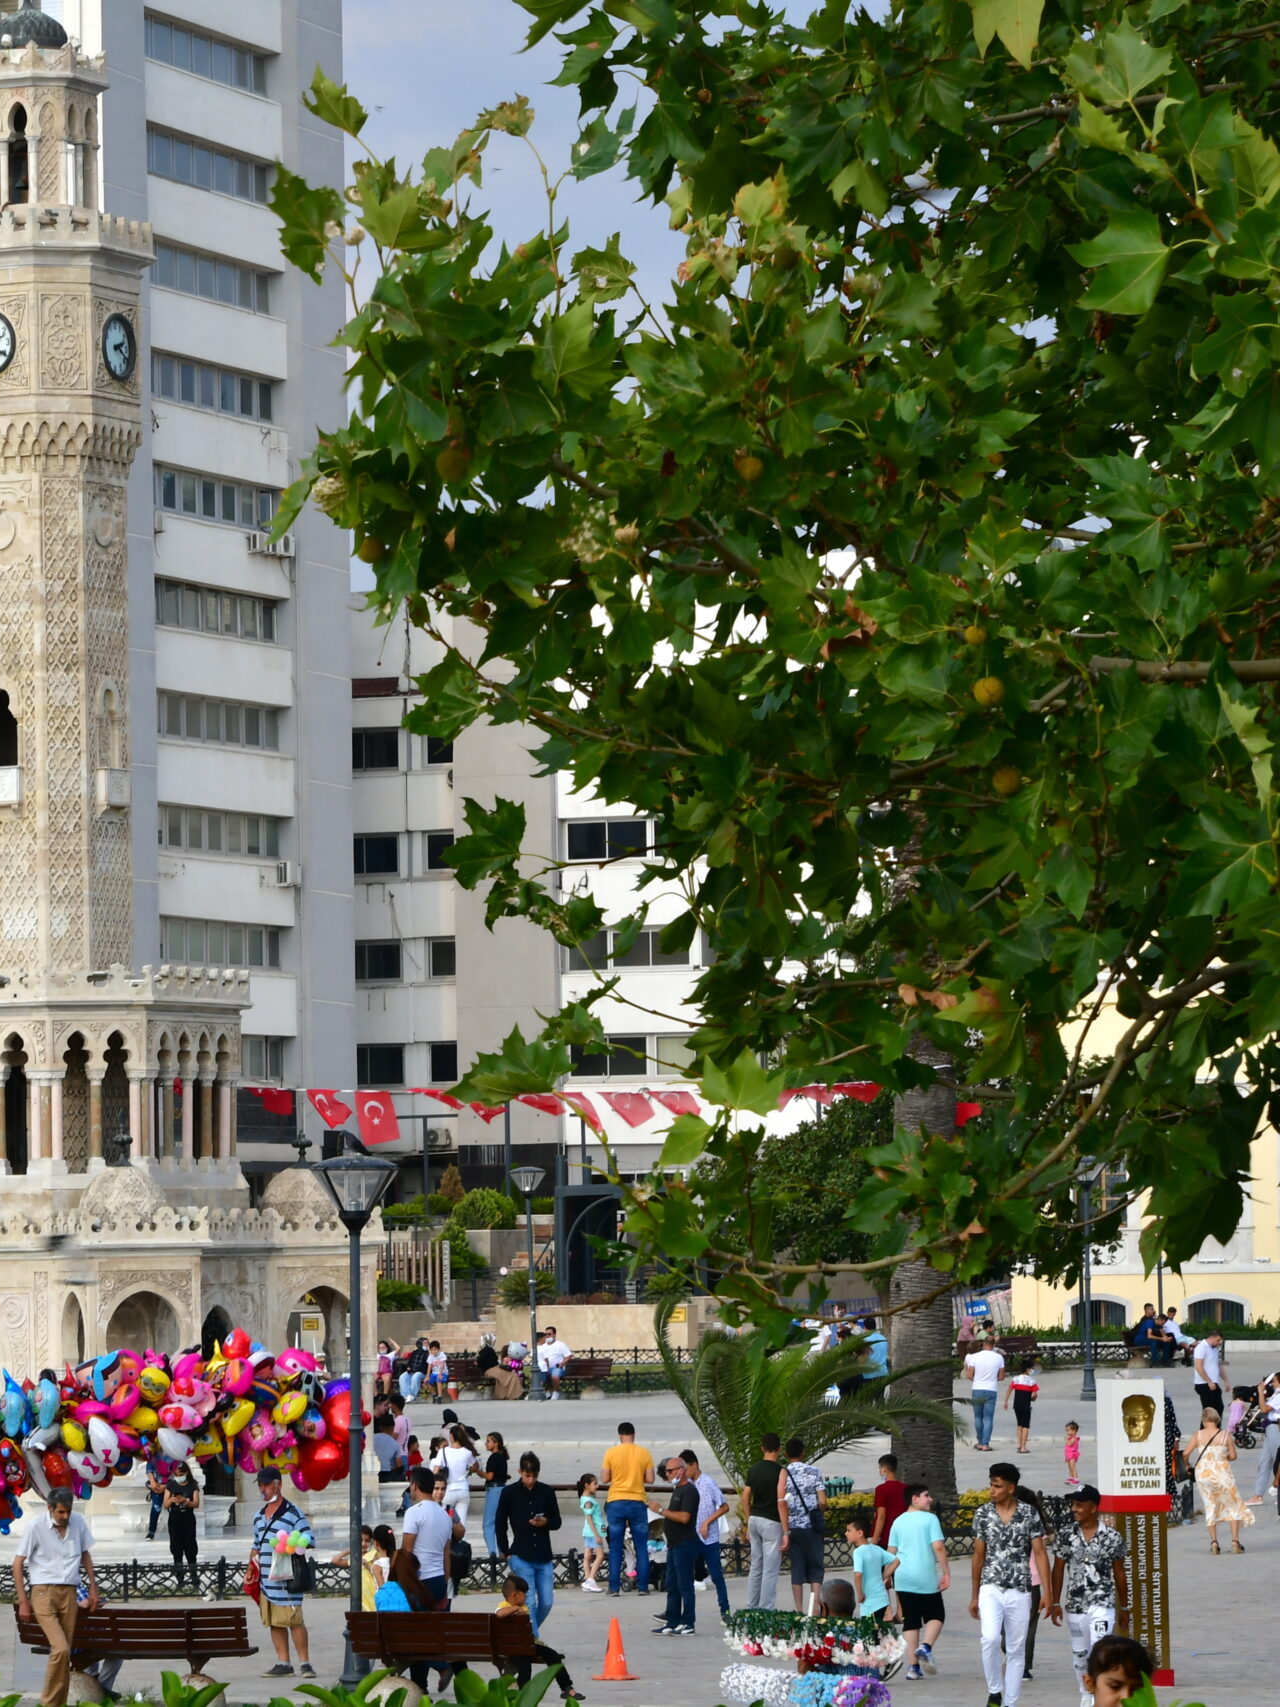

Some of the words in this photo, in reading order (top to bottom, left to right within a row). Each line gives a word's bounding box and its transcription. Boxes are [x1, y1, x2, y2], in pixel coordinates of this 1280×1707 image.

[1120, 1466, 1161, 1477] ATATÜRK
[1123, 1456, 1156, 1465] KONAK
[1120, 1480, 1160, 1489] MEYDANI
[1135, 1514, 1147, 1580] DEMOKRASİ
[1151, 1515, 1160, 1569] BERABERLİK
[1152, 1571, 1163, 1626] KURTULUŞ
